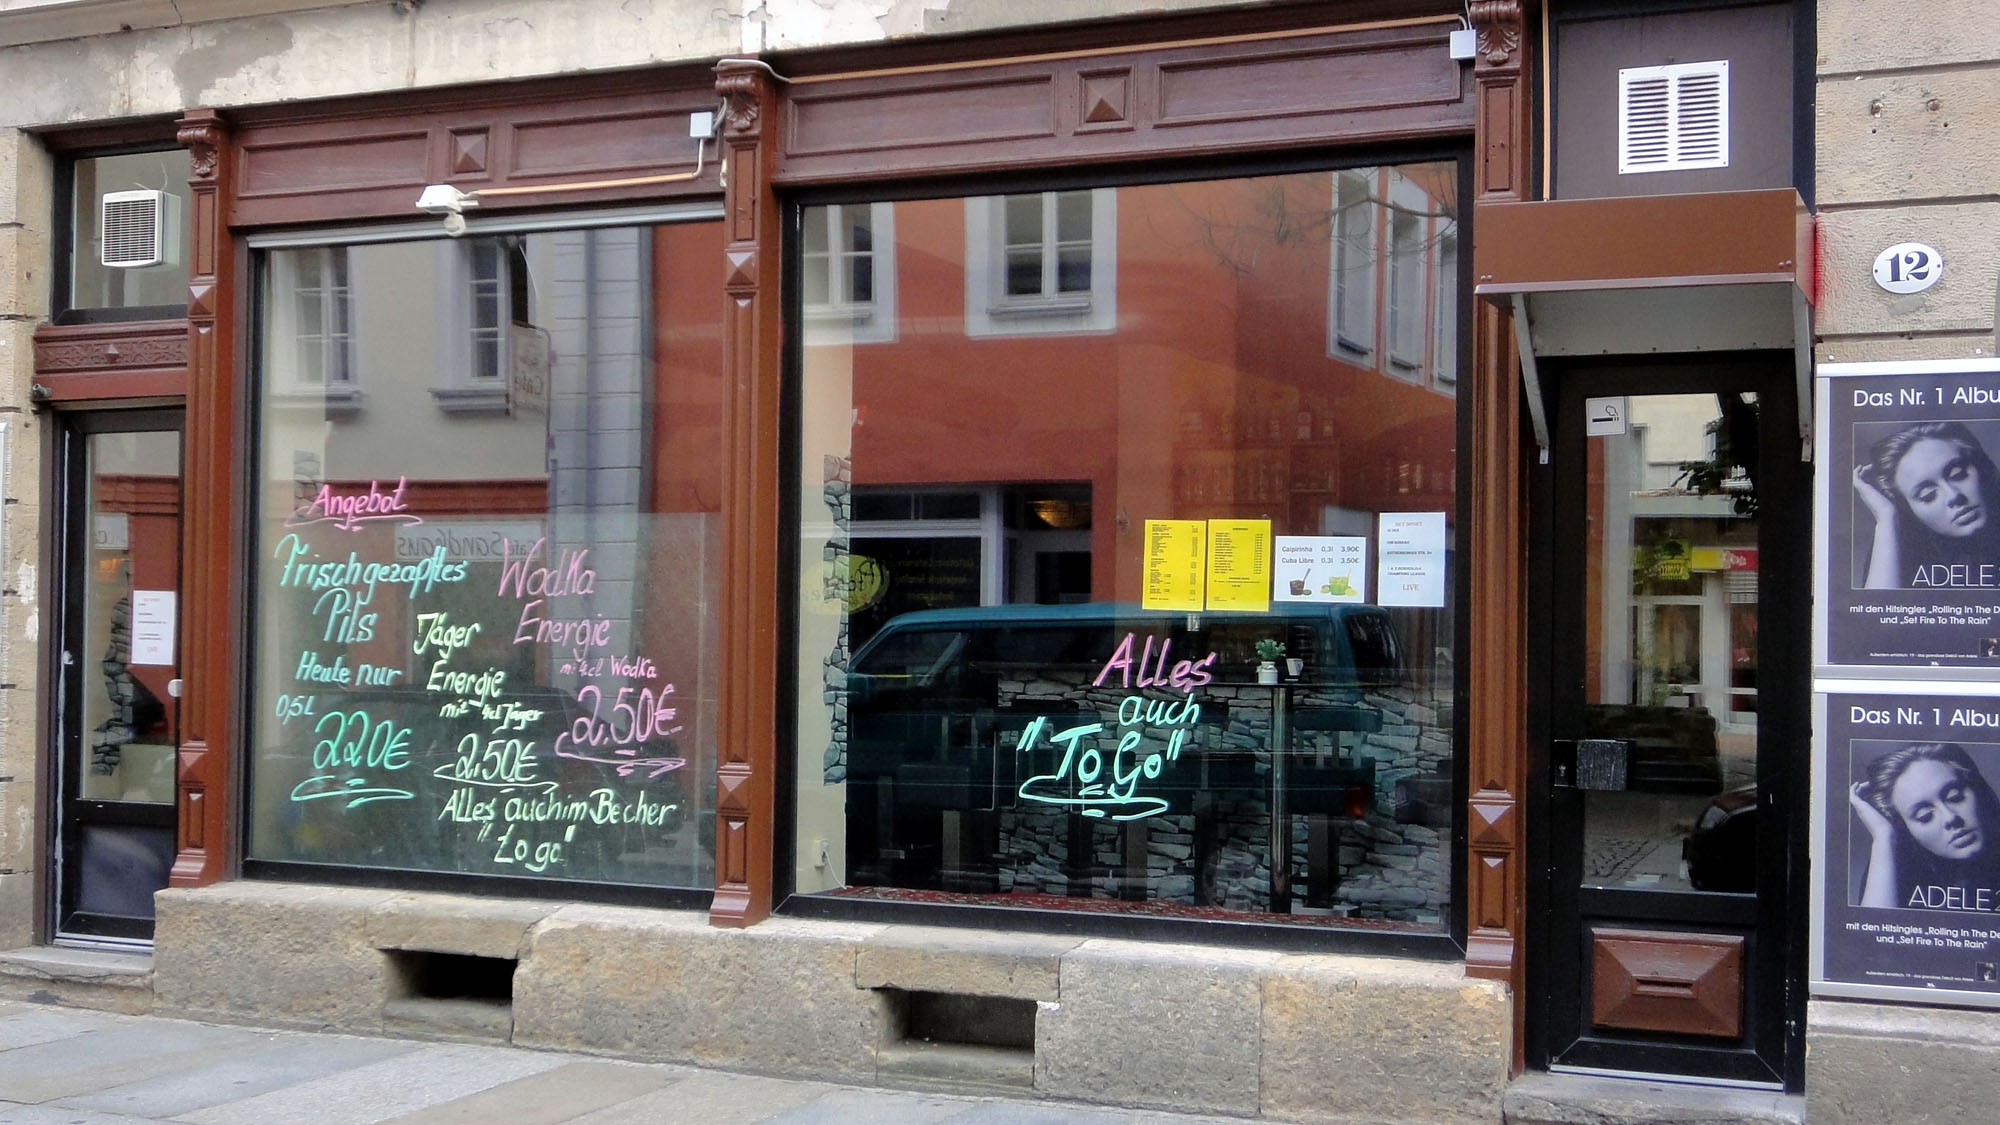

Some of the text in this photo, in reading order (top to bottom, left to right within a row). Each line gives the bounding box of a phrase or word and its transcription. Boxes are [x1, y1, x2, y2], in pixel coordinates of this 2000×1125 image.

[1885, 251, 1930, 283] 12
[1853, 390, 1893, 407] Das
[1900, 388, 1925, 405] Nr.
[1935, 387, 1943, 405] 1
[307, 475, 408, 531] Angebot
[1281, 545, 1313, 553] Caipirinha
[1402, 583, 1420, 591] LIVE
[1911, 564, 1995, 587] ADELE
[312, 587, 379, 643] Pils
[1849, 605, 1863, 613] mit
[1865, 605, 1884, 613] den
[1885, 605, 1926, 615] Hitsingles
[1964, 606, 1973, 614] In
[1975, 606, 1992, 614] The
[1880, 616, 1898, 624] und
[1920, 616, 1936, 624] Fire
[1937, 616, 1948, 624] To
[1949, 616, 1966, 625] The
[413, 611, 482, 660] Jäger
[512, 599, 610, 662] Energie
[295, 650, 403, 686] Heute nur
[1092, 632, 1217, 693] Alles
[426, 659, 506, 708] Energie
[1118, 692, 1201, 726] auch
[1850, 706, 1891, 724] Das
[1897, 707, 1923, 725] Nr.
[1932, 708, 1941, 726] 1
[438, 787, 497, 824] Alles
[1908, 884, 1992, 911] ADELE
[1845, 922, 1860, 931] mit
[1861, 923, 1880, 932] den
[1881, 923, 1923, 935] Hitsingles
[1960, 928, 1970, 937] In
[1971, 929, 1988, 938] The
[1876, 935, 1895, 943] und
[1916, 937, 1932, 946] Fire
[1933, 938, 1944, 947] To
[1945, 938, 1962, 948] The
